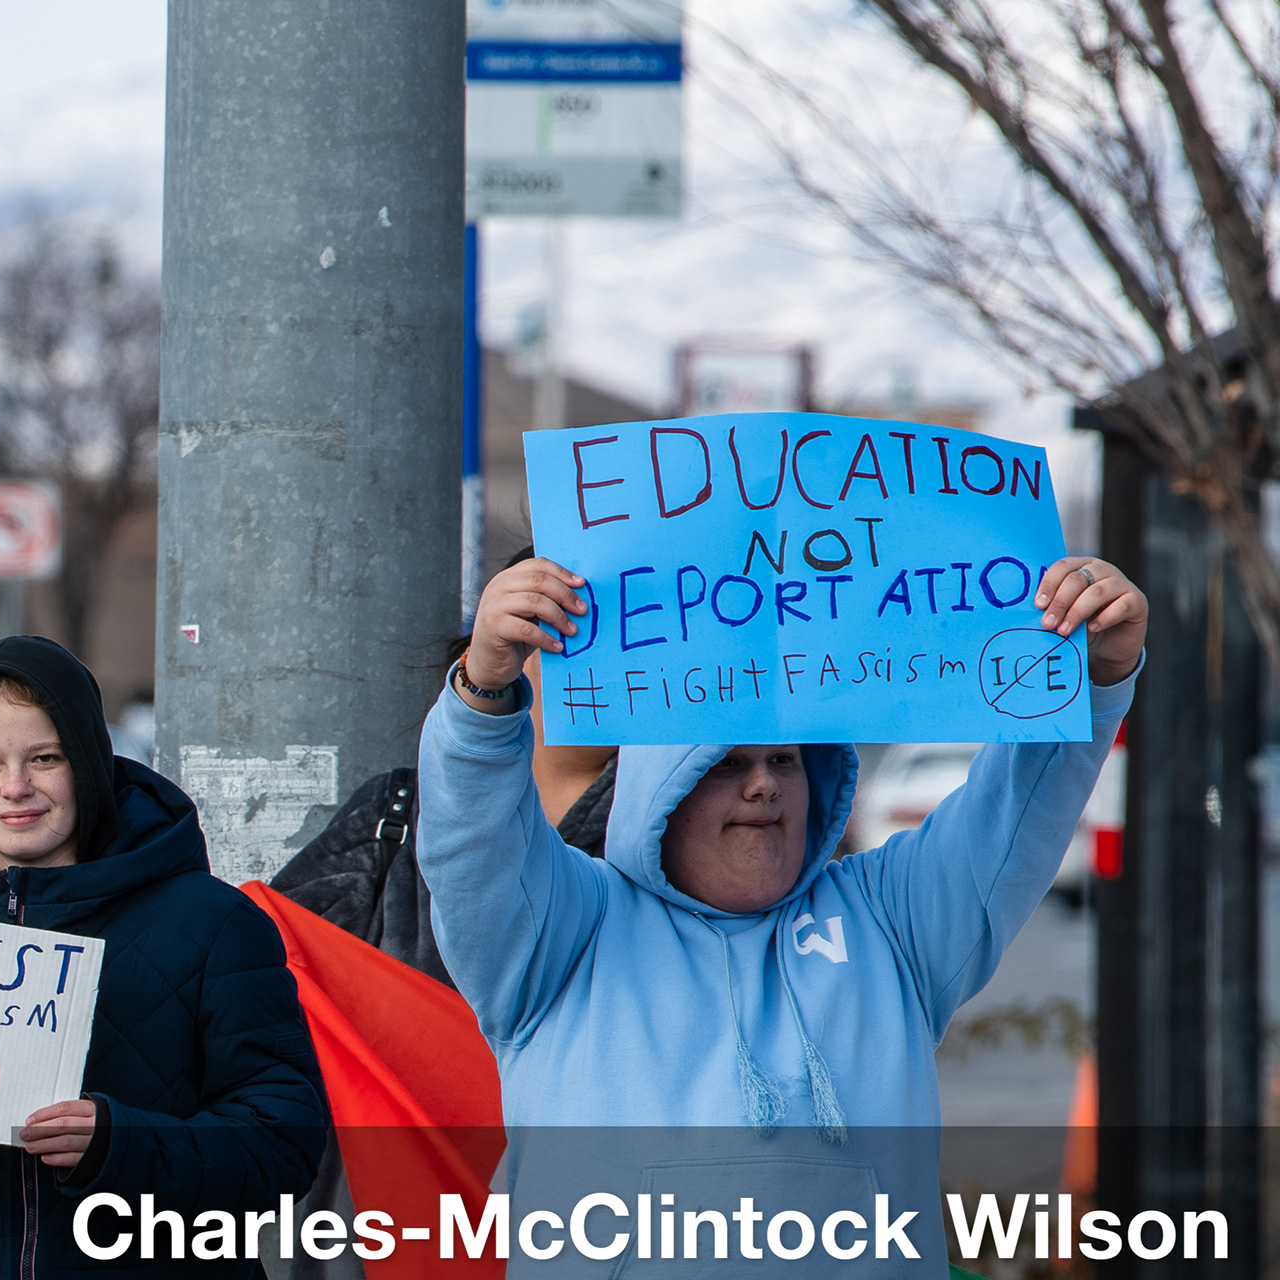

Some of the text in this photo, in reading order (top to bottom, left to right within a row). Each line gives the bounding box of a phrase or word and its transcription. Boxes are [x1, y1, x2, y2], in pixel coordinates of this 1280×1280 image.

[572, 425, 1041, 530] EDUCATION
[743, 517, 883, 575] NOT
[557, 556, 1047, 658] DEPORTATIO
[989, 654, 1067, 692] ICE
